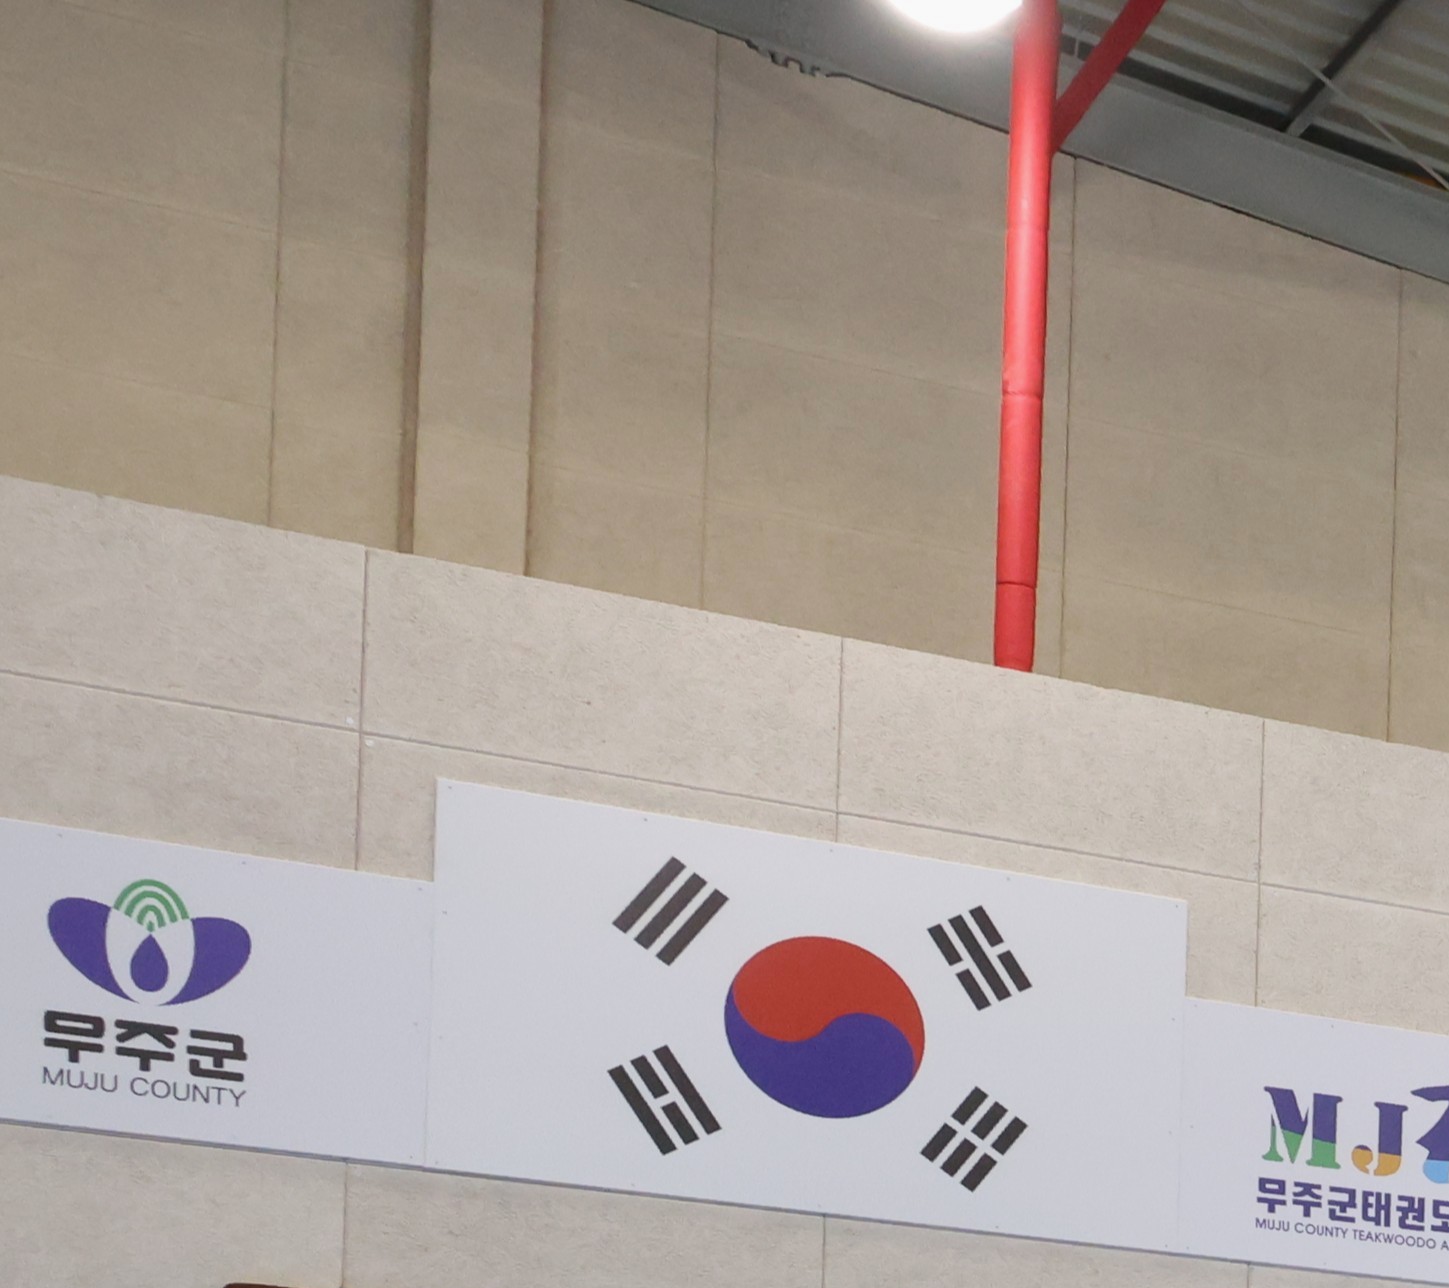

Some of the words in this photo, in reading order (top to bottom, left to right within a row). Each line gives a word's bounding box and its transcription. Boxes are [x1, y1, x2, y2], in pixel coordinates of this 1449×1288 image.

[44, 1010, 247, 1082] 무주군
[42, 1066, 118, 1093] MUJU
[130, 1077, 246, 1108] COUNTY
[1255, 1217, 1290, 1232] MUJU
[1294, 1221, 1348, 1240] COUNTY
[1352, 1228, 1436, 1250] TEAKWOODO
